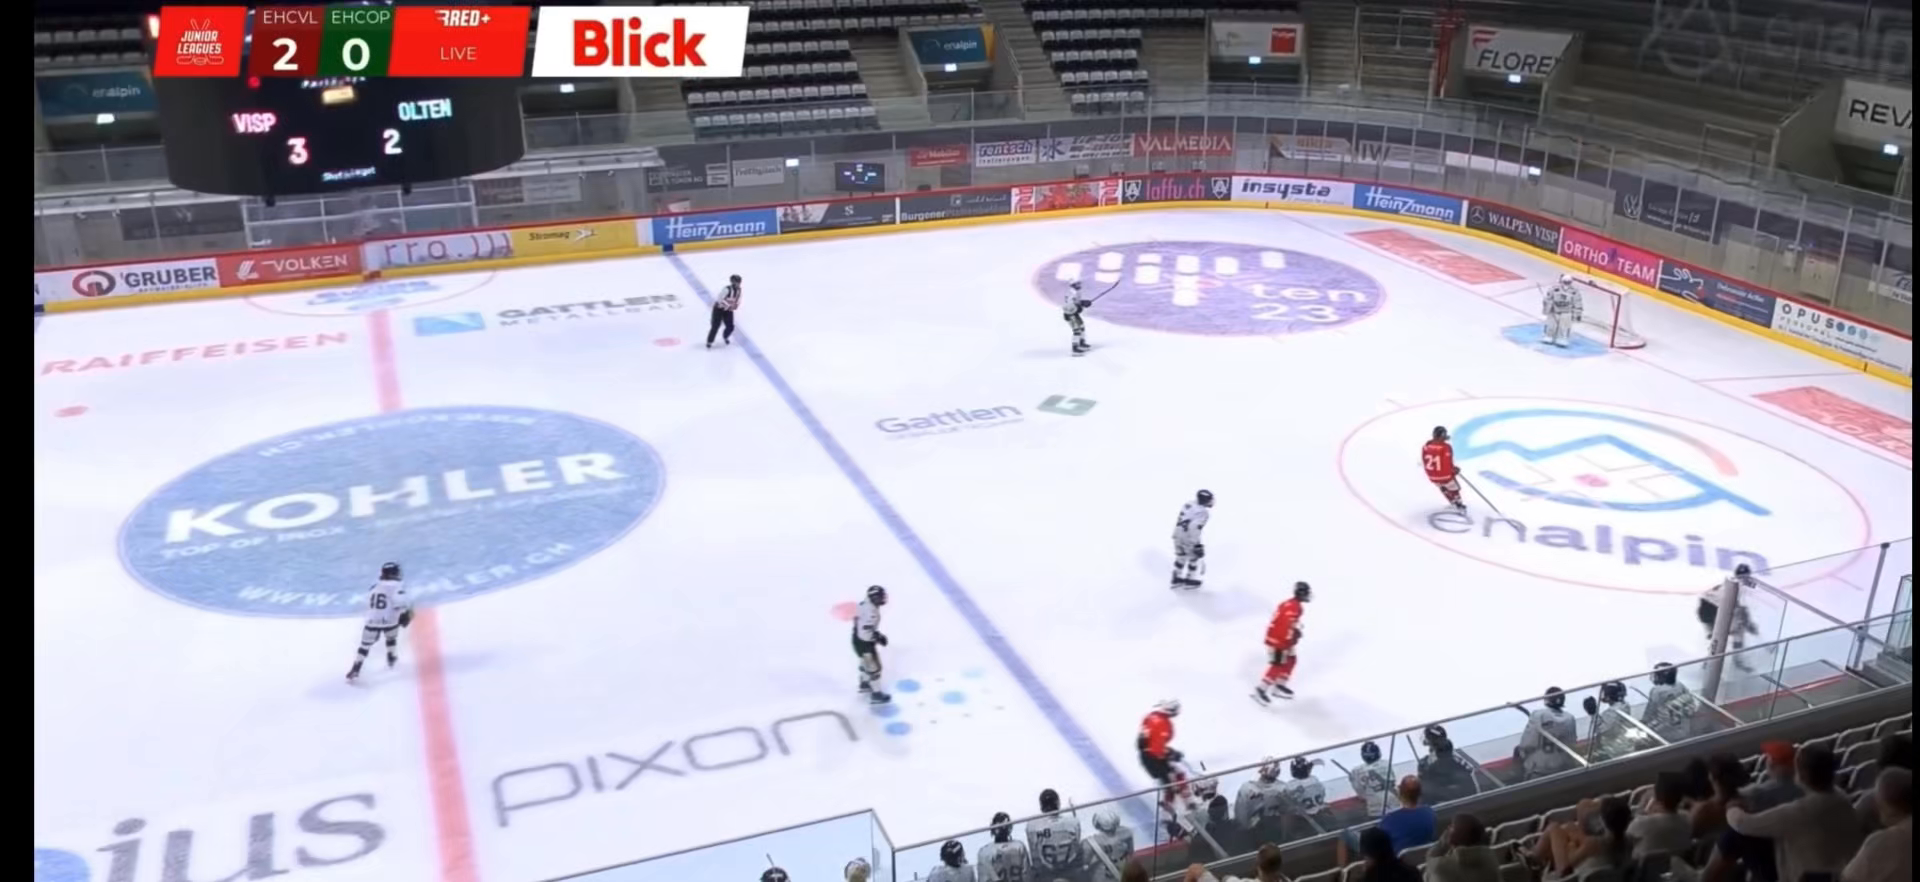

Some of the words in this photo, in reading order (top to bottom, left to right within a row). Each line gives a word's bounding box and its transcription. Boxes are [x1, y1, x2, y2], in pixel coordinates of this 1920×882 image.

[398, 98, 452, 121] OLTEN
[1849, 99, 1912, 129] REV
[233, 113, 276, 133] VISP
[287, 137, 308, 164] 3
[382, 129, 402, 155] 2
[979, 143, 1033, 157] rentsch
[1138, 135, 1233, 151] VALMEDIA
[1146, 178, 1206, 200] laffu.ch
[1242, 179, 1331, 199] insysta
[1489, 212, 1533, 236] WALPEN
[1533, 224, 1558, 243] VISP
[272, 254, 348, 272] VOLKEN
[1564, 241, 1609, 266] ORTHO
[1617, 257, 1655, 282] TEAM
[1251, 282, 1366, 303] ten
[497, 293, 678, 318] GATTLEN
[1250, 303, 1340, 323] 23
[1781, 303, 1835, 329] OPUS
[40, 332, 348, 375] RAIFFEISEN
[874, 404, 1023, 433] Gattlen
[1424, 454, 1441, 471] 21
[165, 452, 627, 543] KOHLER
[1427, 511, 1771, 576] enalpin
[491, 710, 859, 828] pixon
